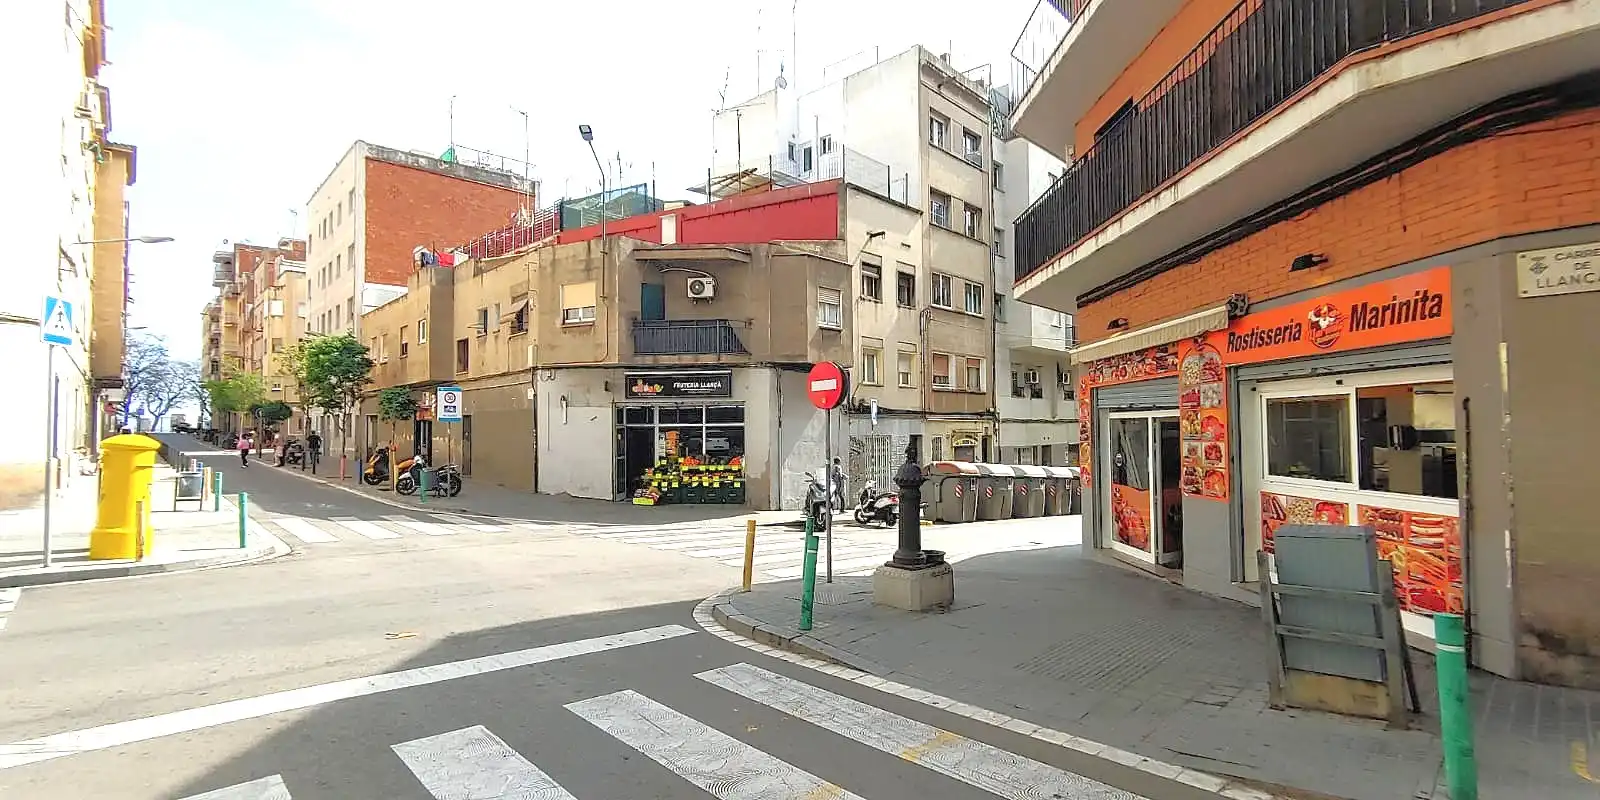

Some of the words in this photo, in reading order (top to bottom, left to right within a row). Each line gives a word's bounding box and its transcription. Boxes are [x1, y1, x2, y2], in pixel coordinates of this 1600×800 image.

[1574, 261, 1591, 271] DE
[1226, 318, 1302, 353] Rostisseria
[1348, 288, 1443, 333] Marinita
